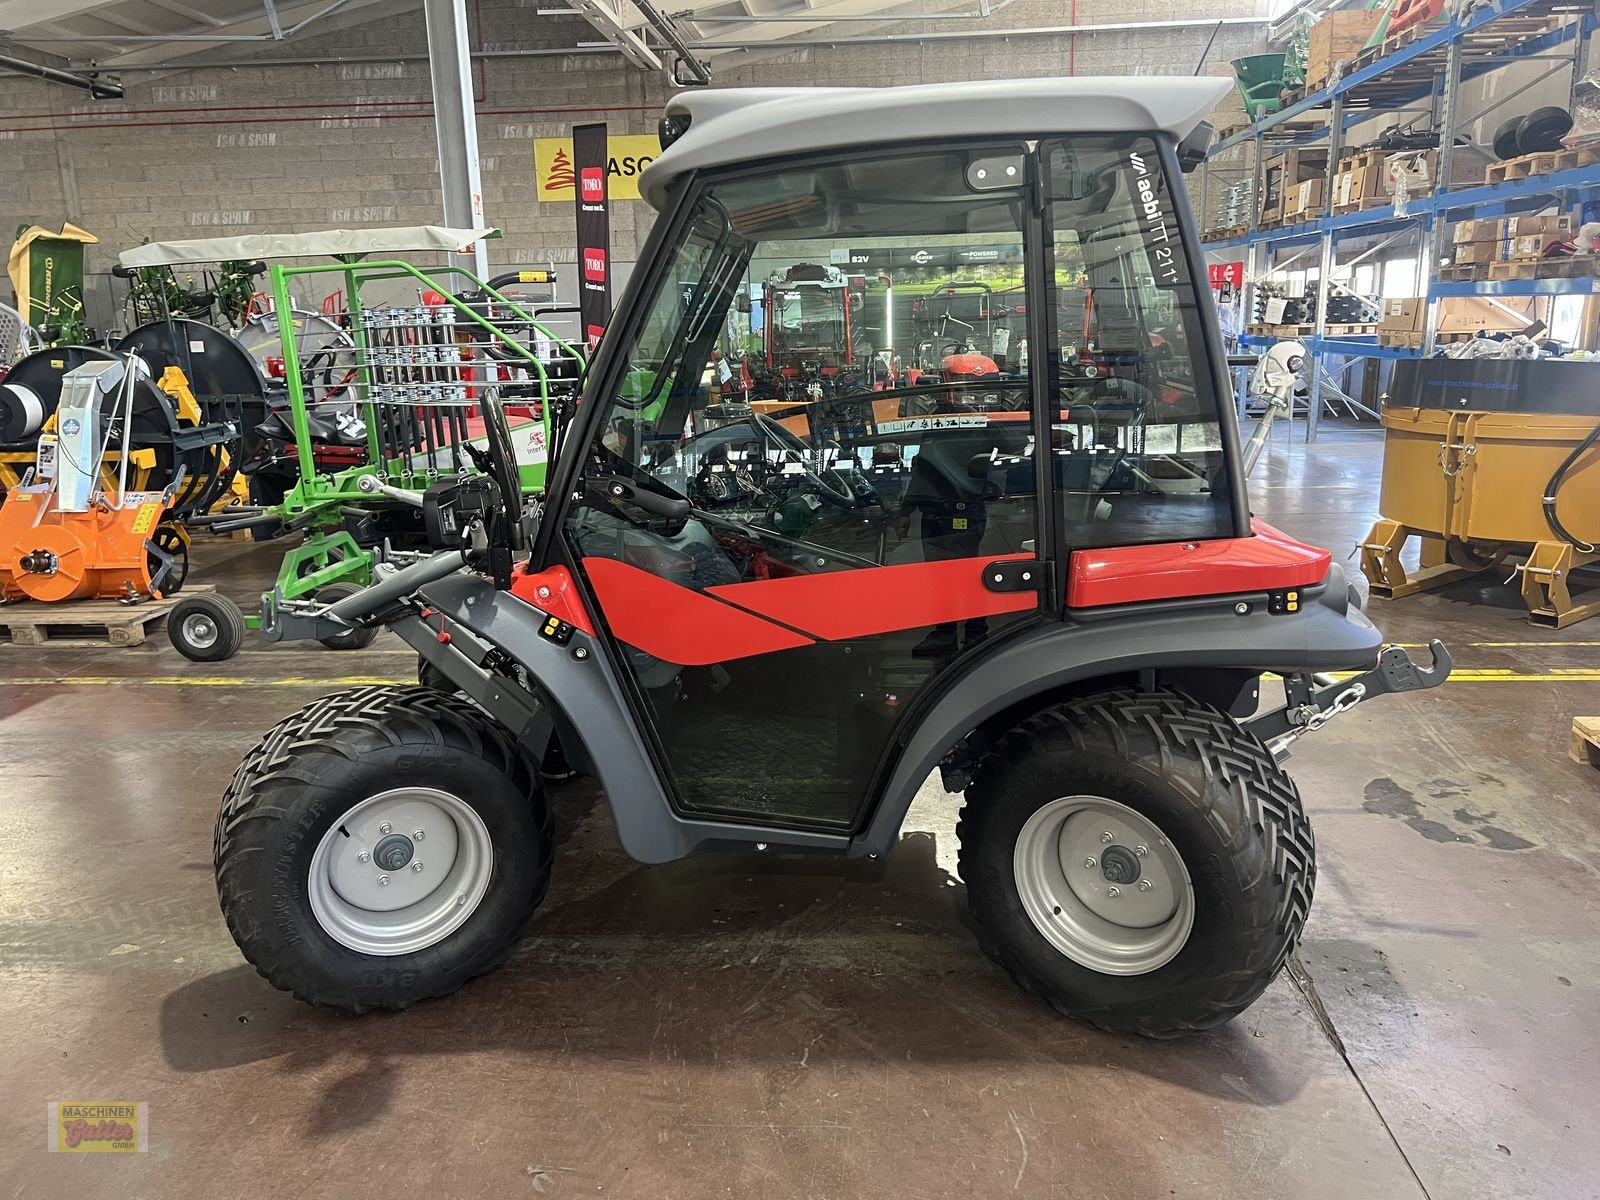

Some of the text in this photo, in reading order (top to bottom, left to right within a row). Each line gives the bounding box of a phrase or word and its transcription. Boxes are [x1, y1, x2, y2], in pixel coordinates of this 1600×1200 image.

[582, 178, 602, 191] TORO
[1137, 179, 1162, 220] aebi
[1150, 221, 1168, 242] TT
[585, 258, 605, 272] TORO
[851, 255, 870, 263] 82V
